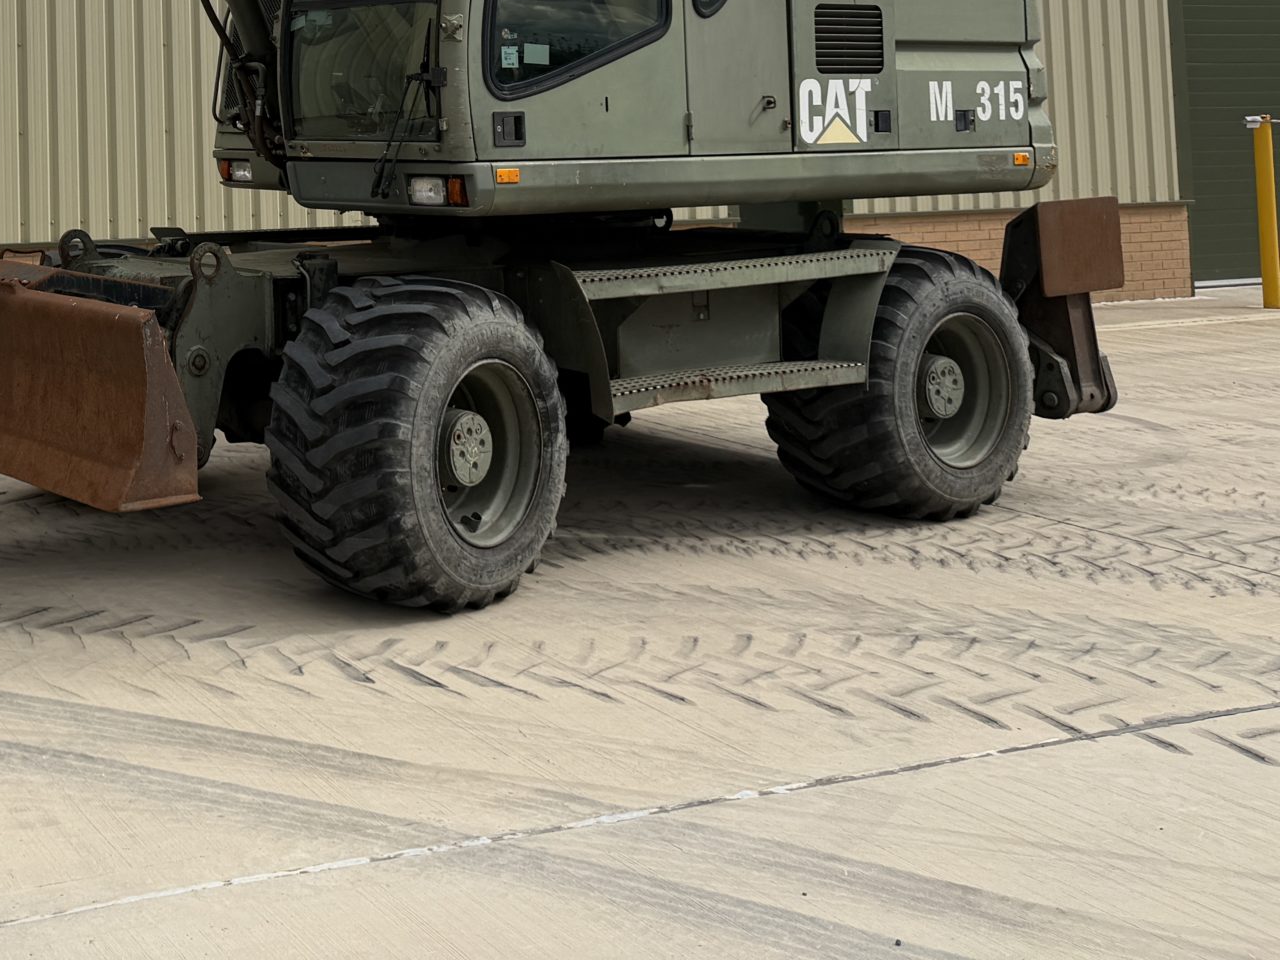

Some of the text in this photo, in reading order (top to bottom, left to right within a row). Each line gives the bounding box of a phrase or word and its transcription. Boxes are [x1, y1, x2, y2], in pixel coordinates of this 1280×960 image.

[799, 78, 871, 144] CAT
[929, 80, 1024, 121] M 315
